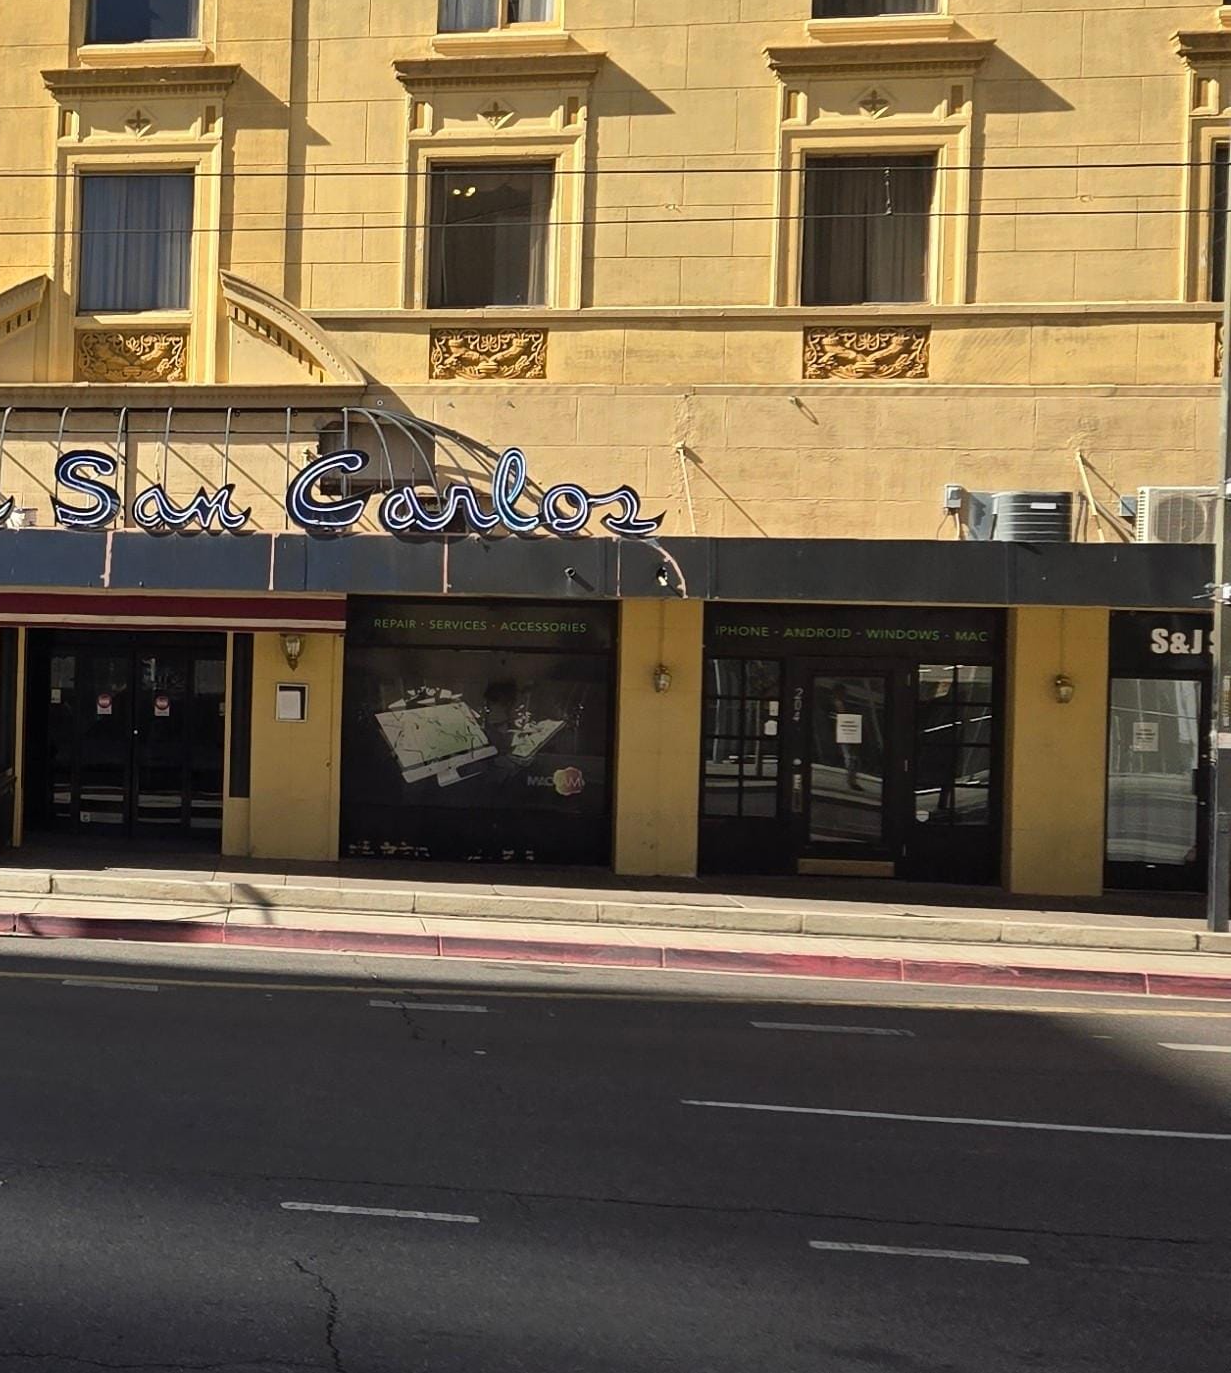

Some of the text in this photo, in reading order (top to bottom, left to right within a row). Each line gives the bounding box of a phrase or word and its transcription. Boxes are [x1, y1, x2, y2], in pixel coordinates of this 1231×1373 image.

[50, 448, 253, 529] San
[286, 446, 668, 536] Carlos
[374, 618, 587, 634] REPAIR SERVICES ACCESSORIES
[783, 626, 852, 639] ANDROID
[865, 628, 941, 641] WINDOWS
[954, 630, 989, 643] MAC
[1151, 628, 1204, 655] S&J
